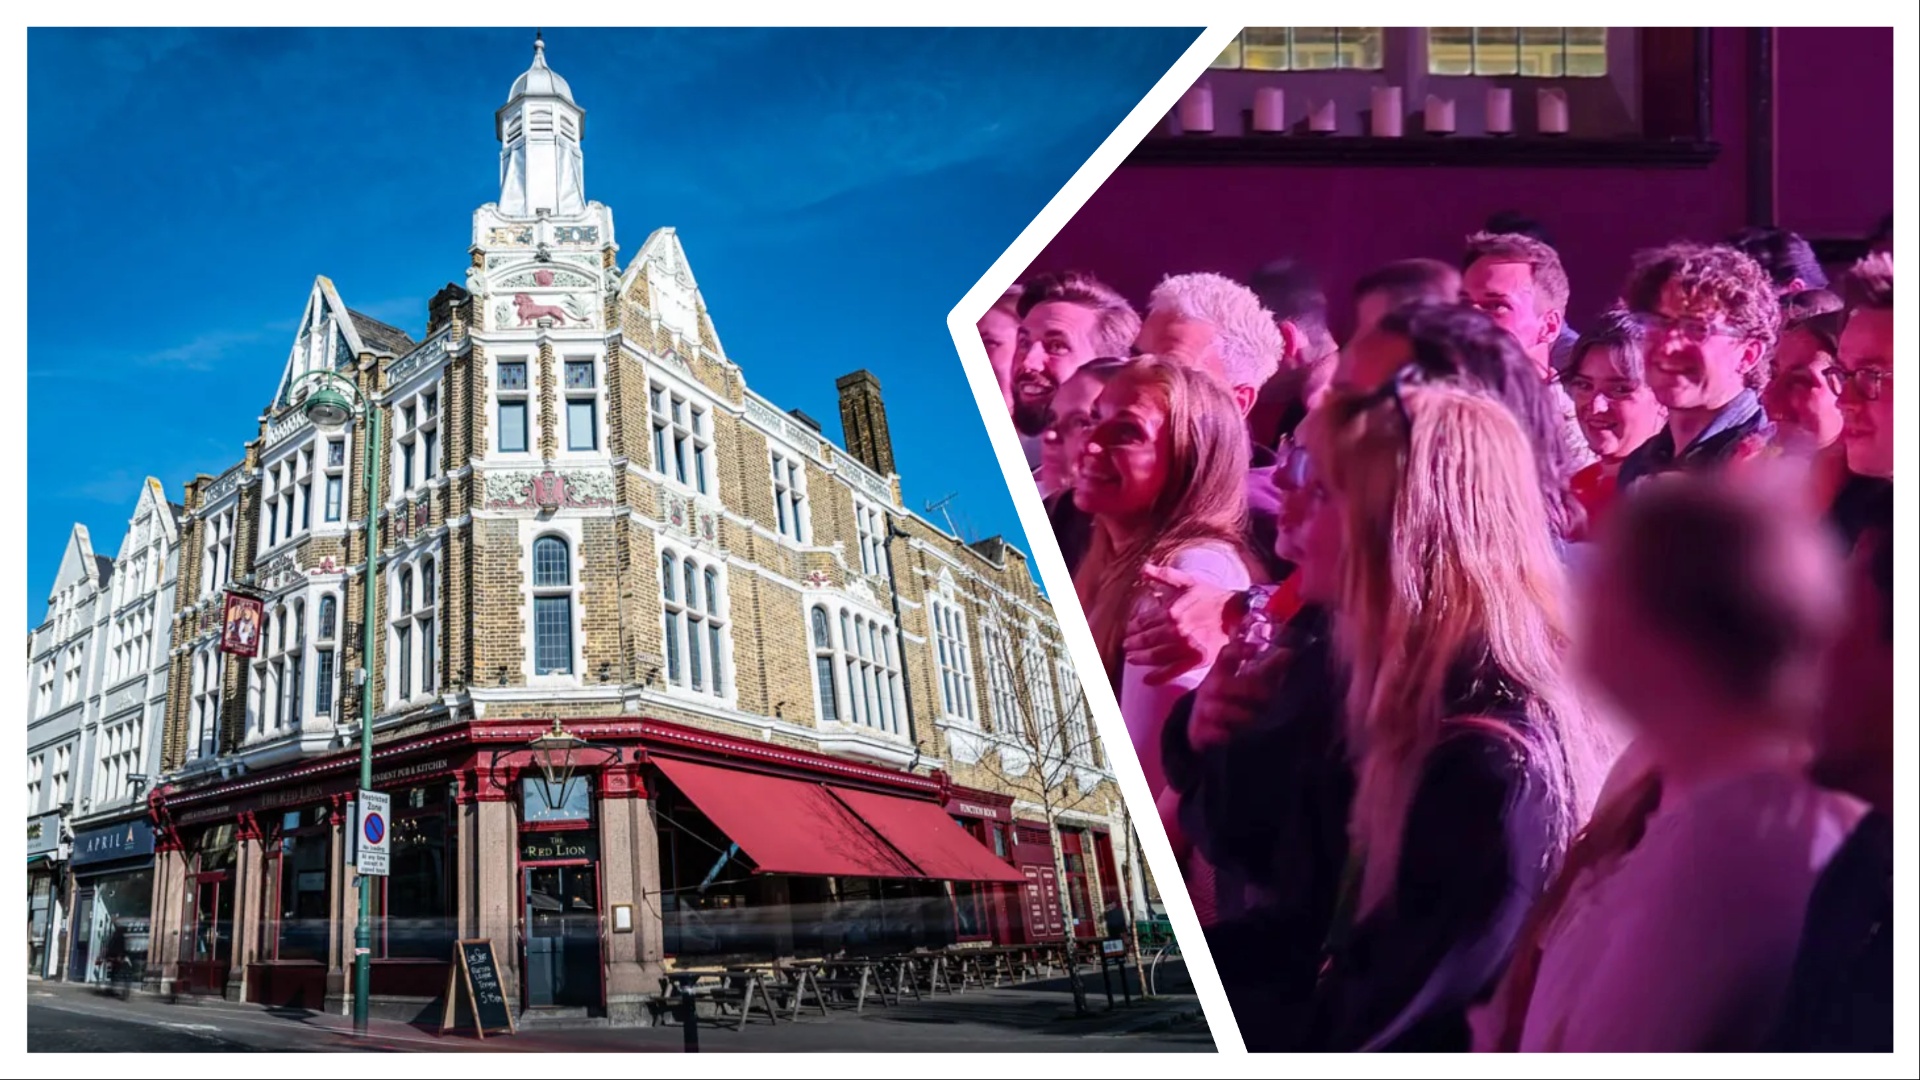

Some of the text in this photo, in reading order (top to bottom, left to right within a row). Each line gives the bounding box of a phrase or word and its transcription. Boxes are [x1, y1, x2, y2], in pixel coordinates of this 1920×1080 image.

[416, 759, 448, 773] KITCHEN
[361, 792, 388, 804] Restricted
[367, 801, 382, 811] Zone
[86, 832, 121, 853] APRIL
[528, 844, 586, 857] RED LION
